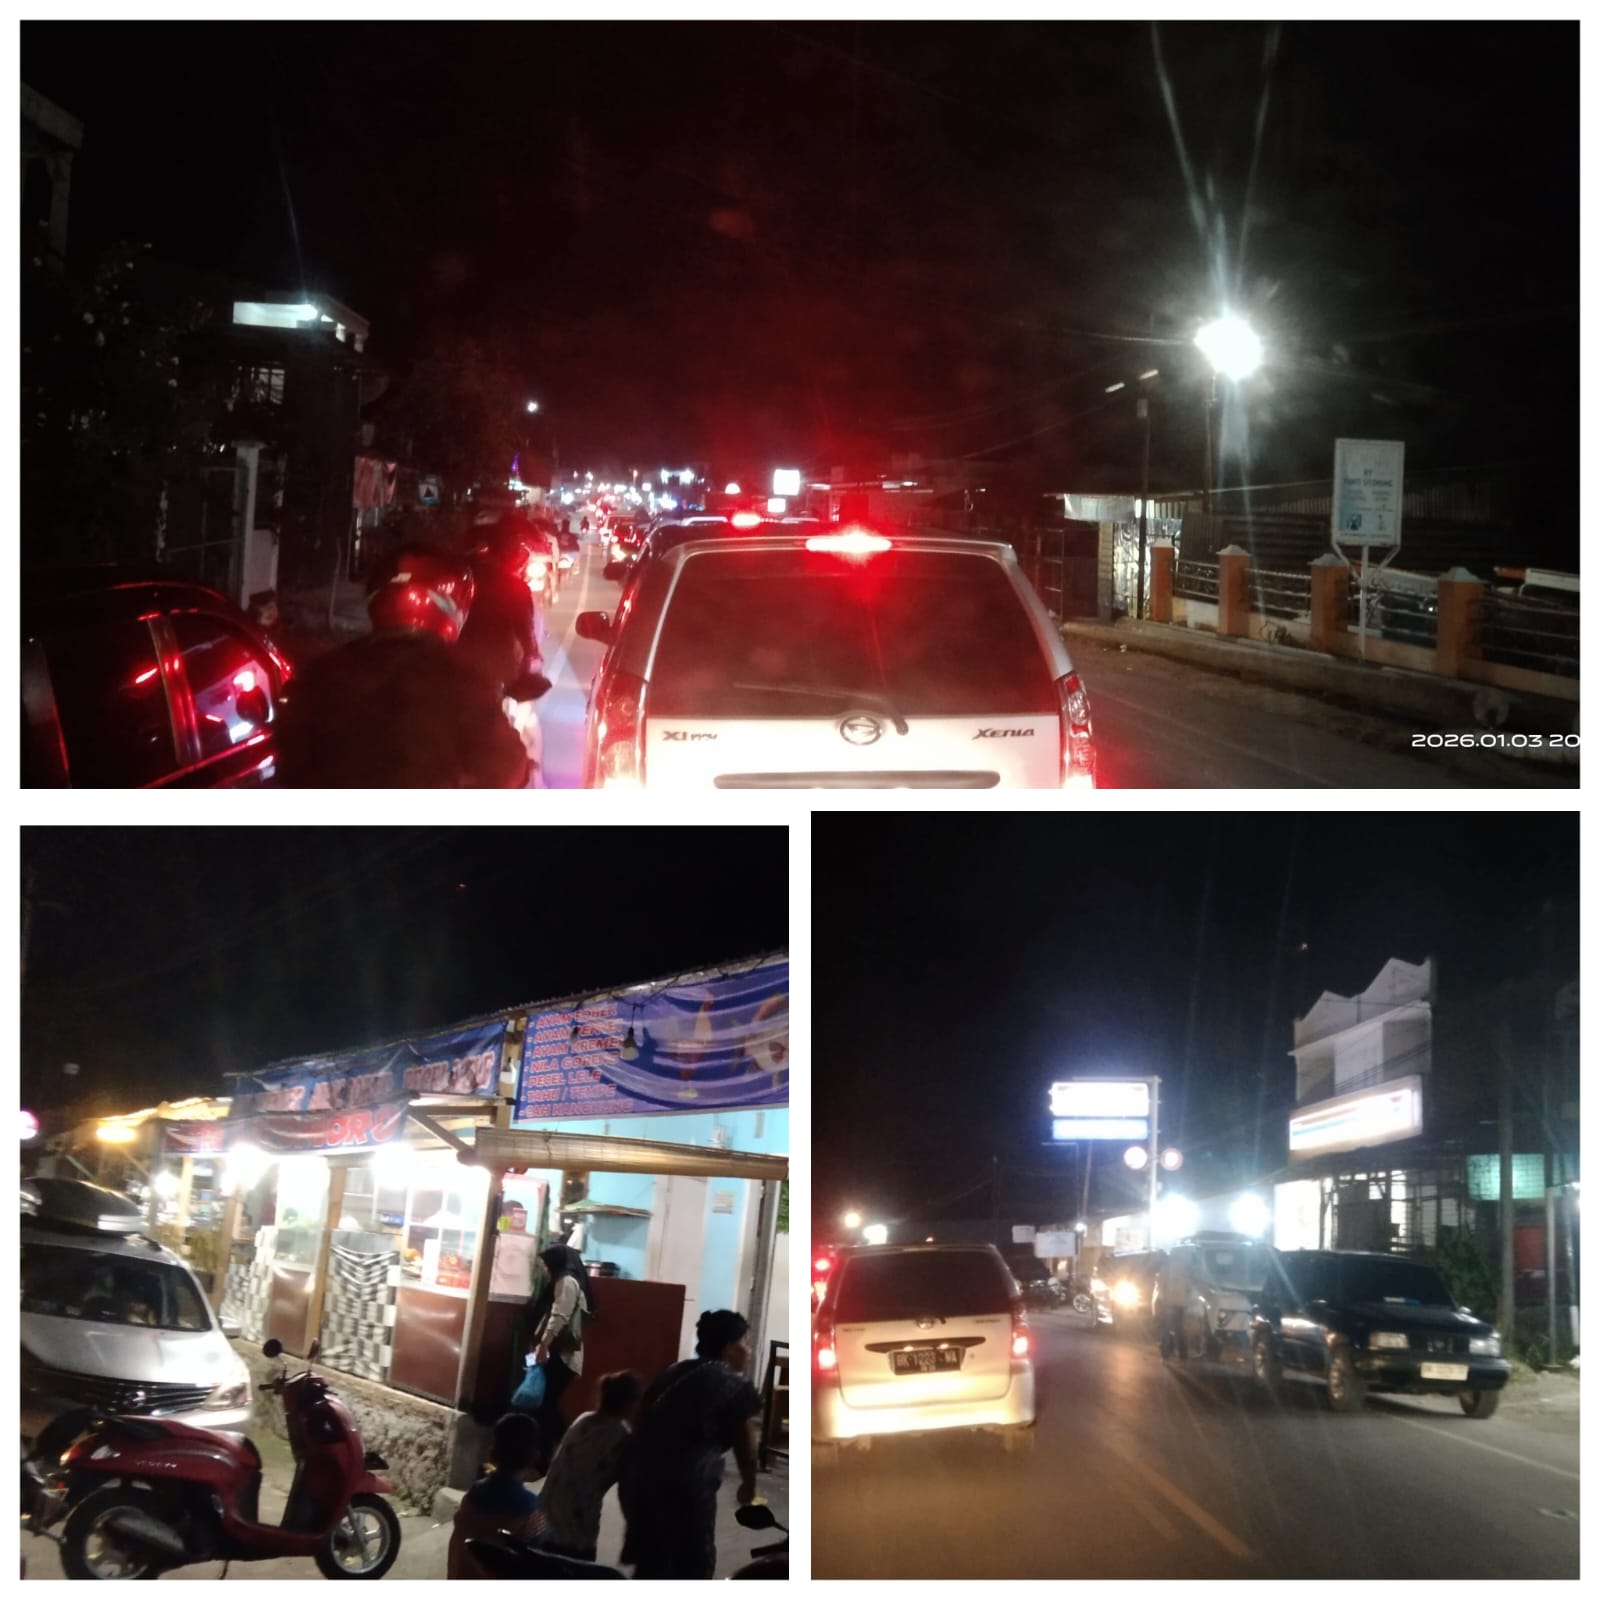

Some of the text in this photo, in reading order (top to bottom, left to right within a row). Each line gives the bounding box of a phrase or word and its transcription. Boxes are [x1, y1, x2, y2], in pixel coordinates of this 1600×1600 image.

[535, 1028, 570, 1043] AYAM
[532, 1042, 569, 1058] AYAM
[530, 1059, 559, 1073] NILA
[528, 1069, 601, 1087] PECEL LELE
[527, 1087, 560, 1103] TAHU
